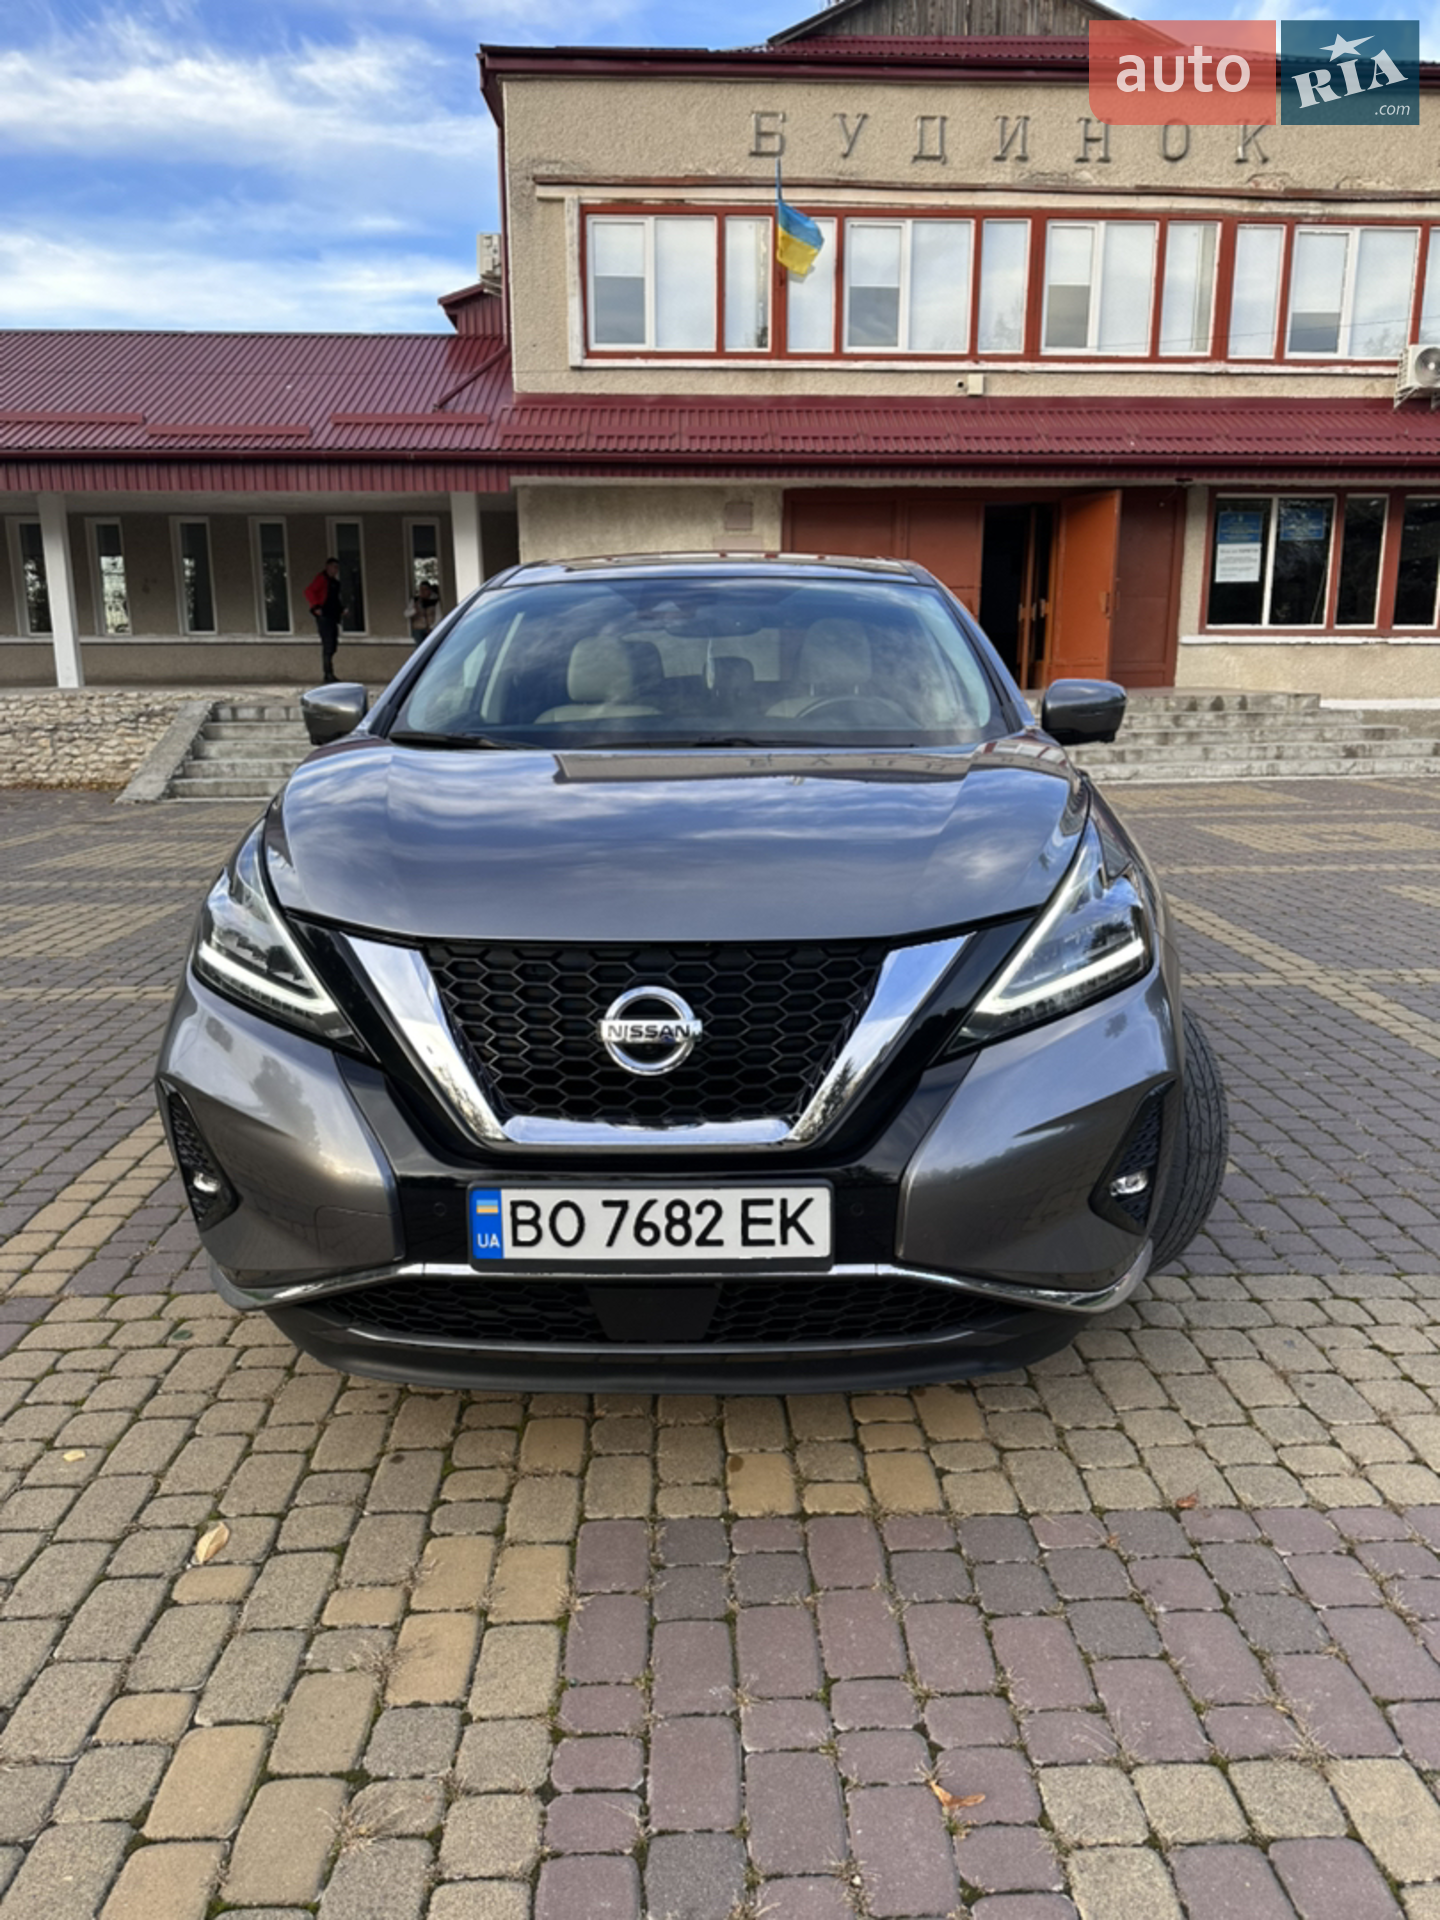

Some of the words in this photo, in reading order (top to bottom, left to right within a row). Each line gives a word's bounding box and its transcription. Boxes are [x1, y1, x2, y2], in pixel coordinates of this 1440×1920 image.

[748, 111, 1271, 165] БУДИНОК
[606, 1024, 692, 1039] NISSAN
[509, 1199, 586, 1248] BO
[601, 1198, 724, 1248] 7682
[740, 1197, 815, 1247] EK
[477, 1233, 501, 1249] UA
